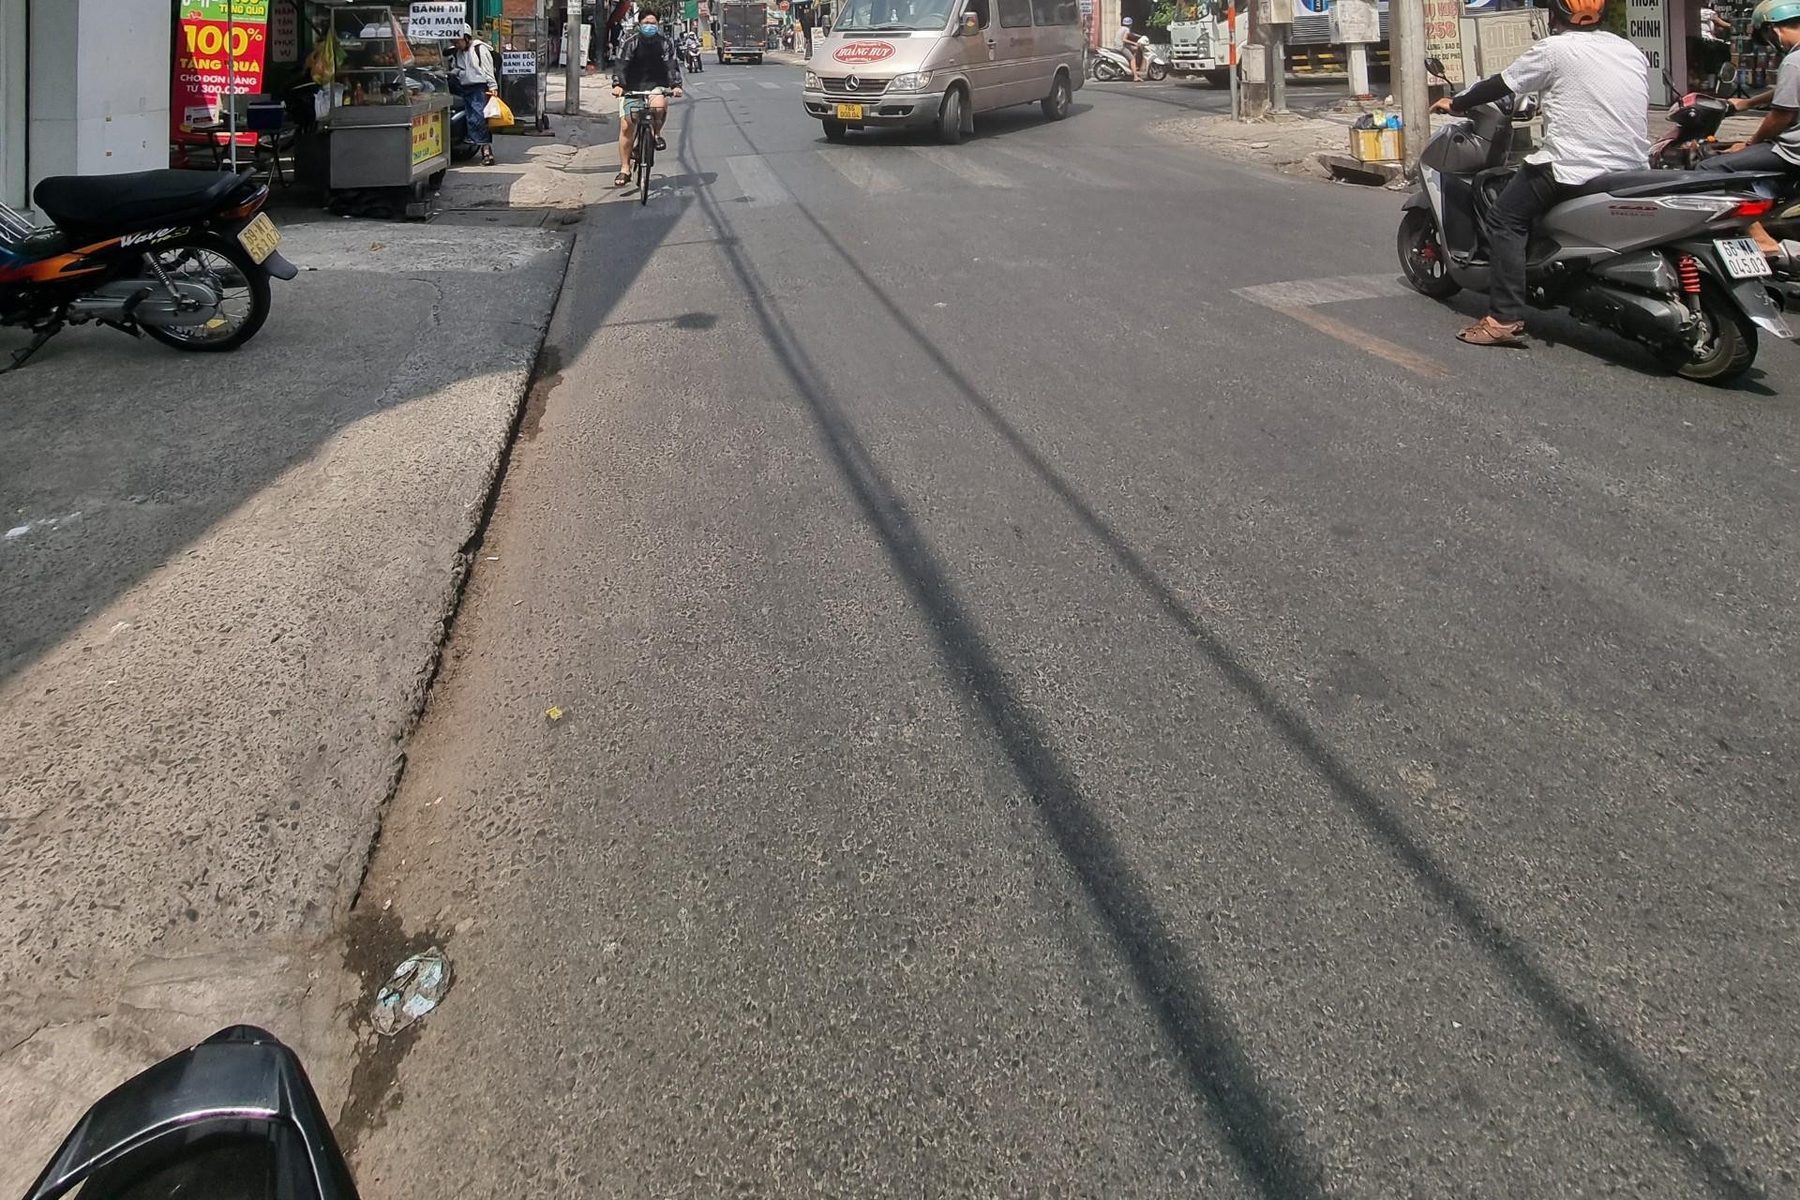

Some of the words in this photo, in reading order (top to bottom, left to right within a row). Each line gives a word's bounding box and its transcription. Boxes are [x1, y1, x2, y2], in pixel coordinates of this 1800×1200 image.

[219, 4, 243, 15] TNG
[412, 5, 445, 14] BÁNH
[1630, 19, 1661, 39] CHÍNH
[184, 24, 263, 57] 100%
[180, 74, 202, 83] CHO
[186, 83, 198, 93] TỪ
[120, 227, 177, 249] Wave
[1728, 257, 1767, 275] 045.03
